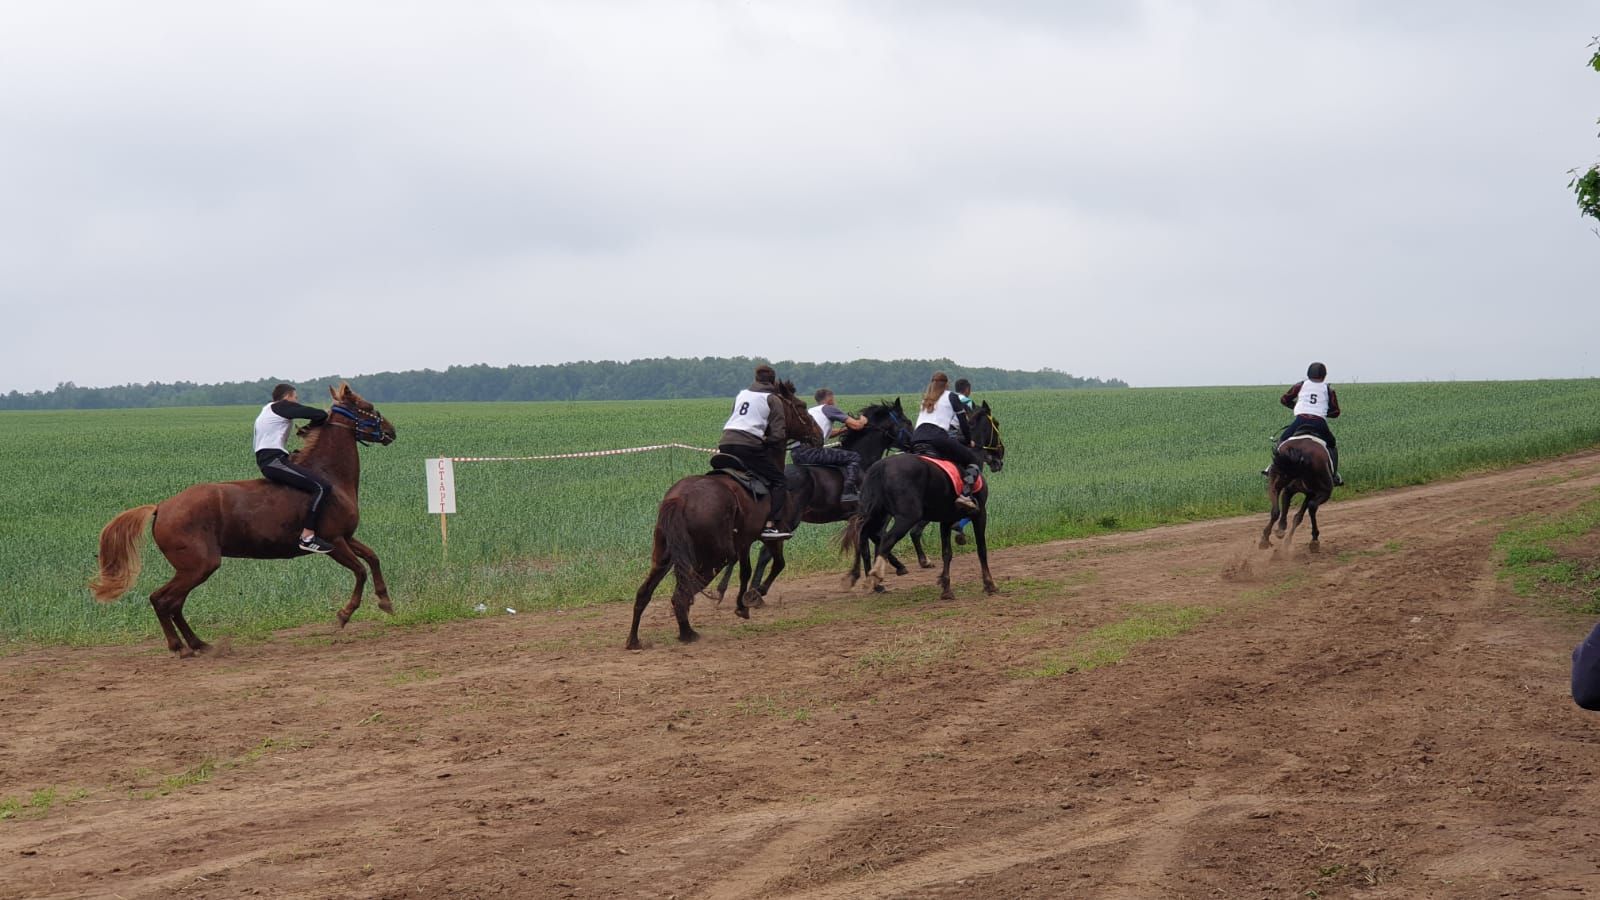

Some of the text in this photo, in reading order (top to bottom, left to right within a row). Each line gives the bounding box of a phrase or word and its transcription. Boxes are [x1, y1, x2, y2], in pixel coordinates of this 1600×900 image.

[1309, 393, 1318, 405] 5
[739, 401, 750, 416] 8
[438, 460, 446, 513] СТАРТ
